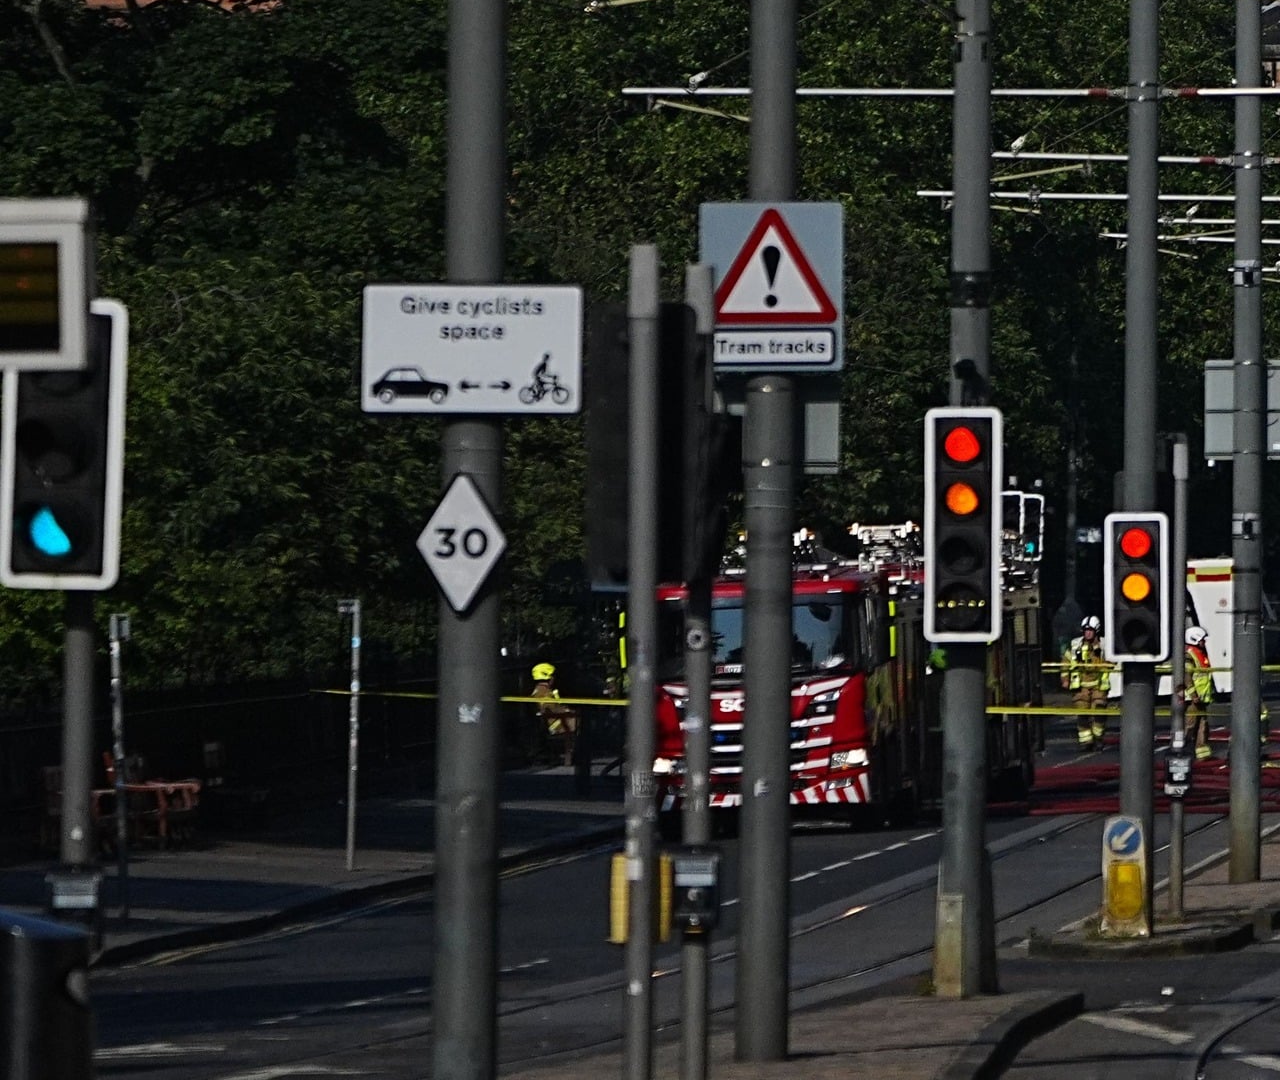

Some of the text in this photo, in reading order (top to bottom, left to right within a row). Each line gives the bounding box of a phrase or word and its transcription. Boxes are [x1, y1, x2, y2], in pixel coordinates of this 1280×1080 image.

[400, 296, 544, 318] Give cyclists
[440, 325, 505, 342] space
[716, 340, 825, 354] Tram tracks
[434, 528, 487, 558] 30
